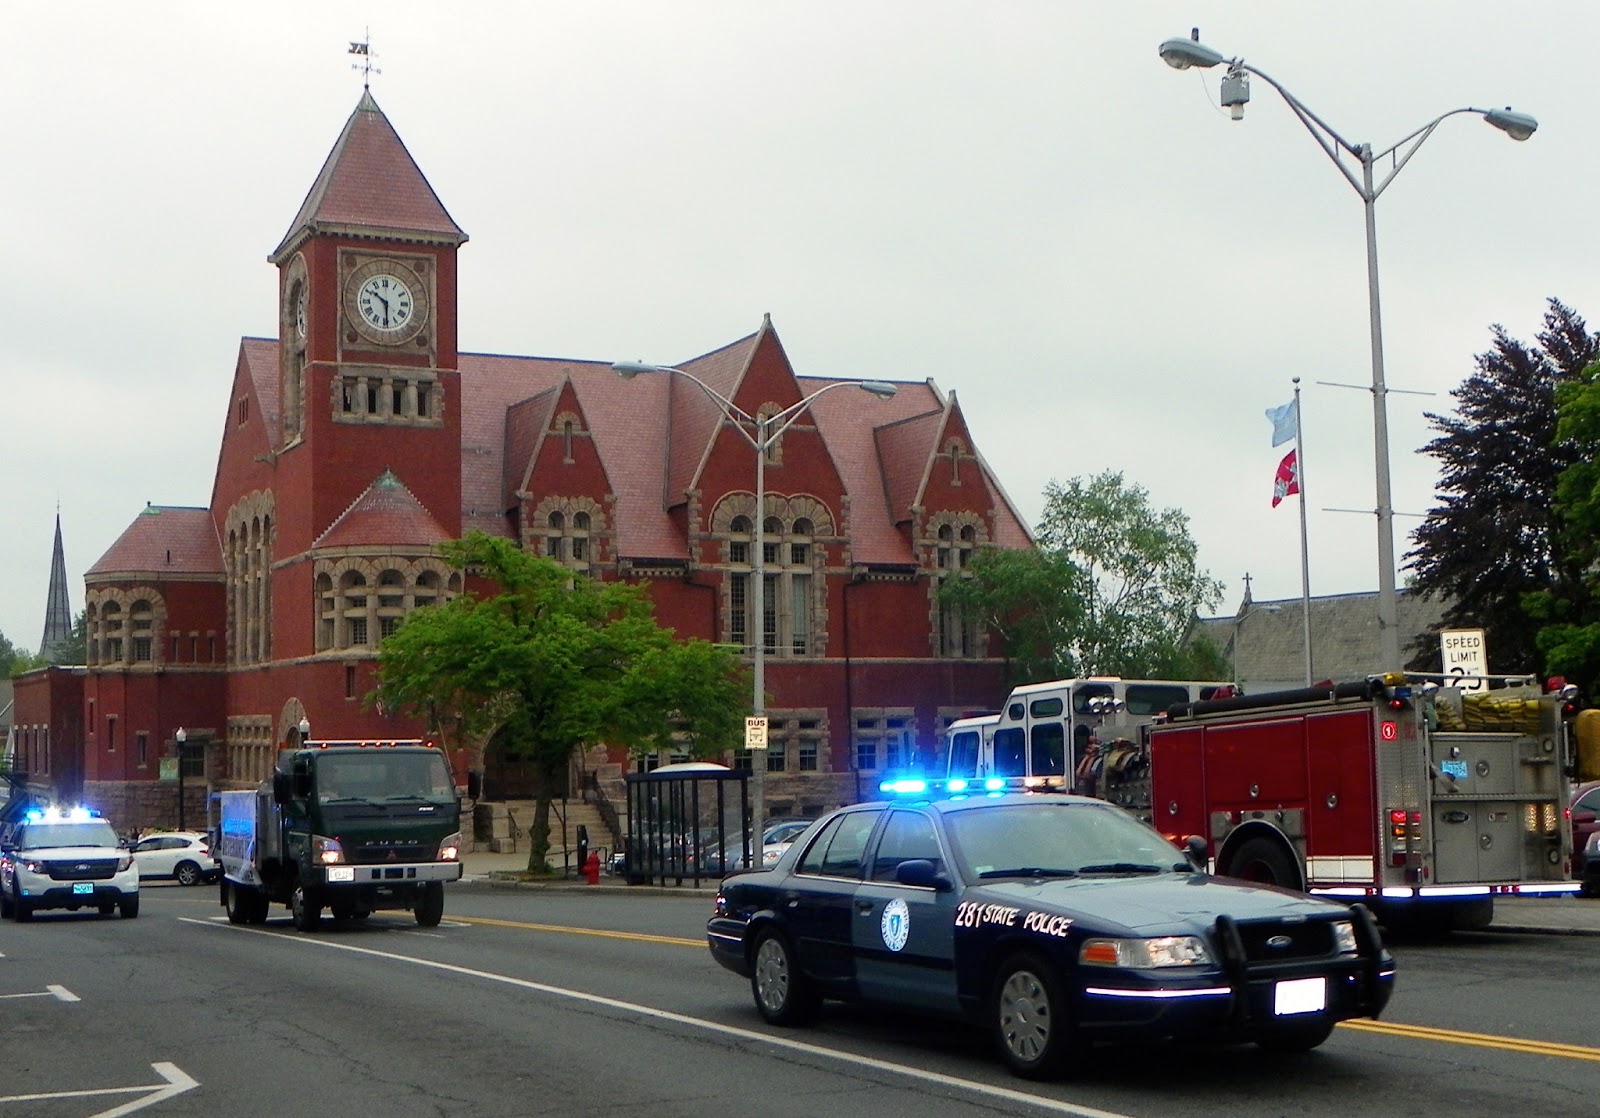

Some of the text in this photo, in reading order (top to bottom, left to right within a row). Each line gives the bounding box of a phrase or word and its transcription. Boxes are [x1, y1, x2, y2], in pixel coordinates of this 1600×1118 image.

[1446, 637, 1480, 649] SPEED
[1450, 651, 1477, 663] LIMIT
[747, 719, 766, 727] BUS
[955, 901, 1075, 938] 281 STATE POLICE
